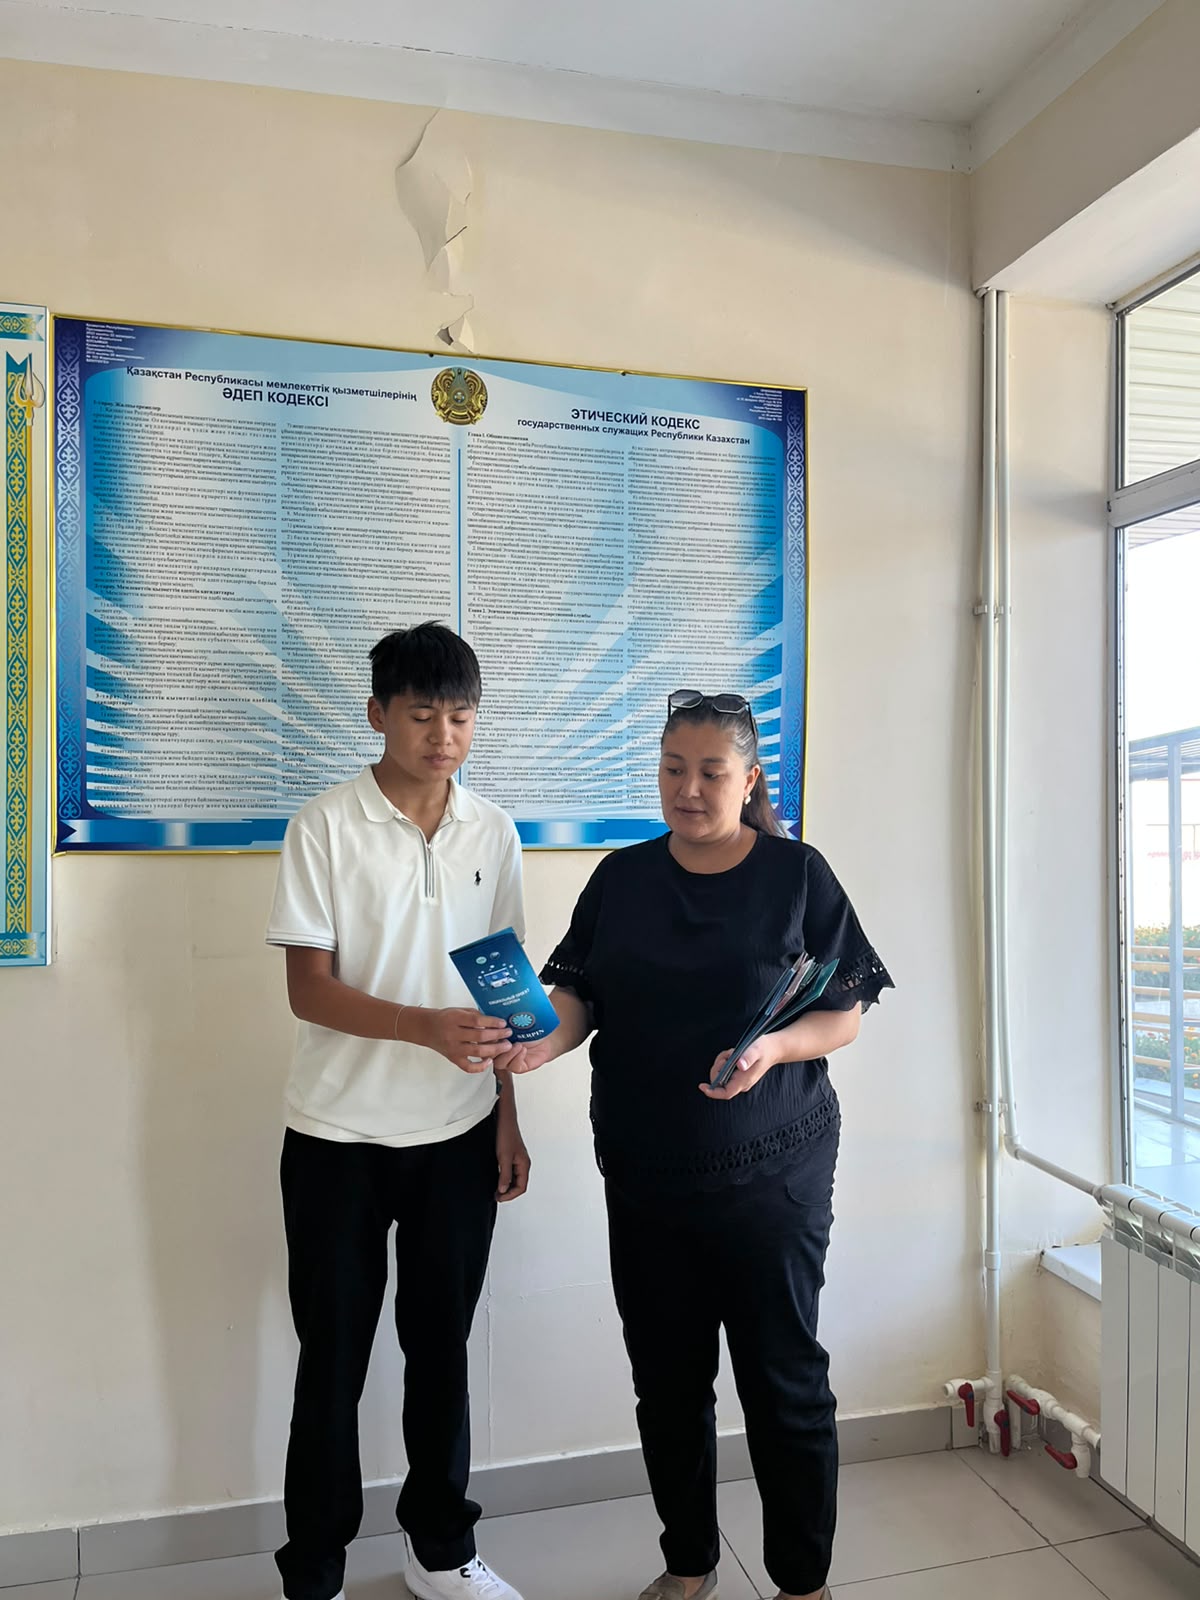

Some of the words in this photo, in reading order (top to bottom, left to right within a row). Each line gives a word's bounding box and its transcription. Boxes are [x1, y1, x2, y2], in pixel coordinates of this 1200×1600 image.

[126, 366, 182, 380] Қазақстан
[185, 372, 263, 387] Республикасы
[266, 380, 330, 392] мемлекеттік
[332, 387, 417, 401] қызметшілерінің
[222, 388, 262, 402] ӘДЕП
[268, 392, 328, 407] КОДЕКСІ
[571, 408, 648, 425] ЭТИЧЕСКИЙ
[652, 416, 700, 430] КОДЕКС
[518, 420, 600, 432] государственных
[602, 426, 648, 437] служащих
[651, 429, 704, 440] Республики
[706, 434, 750, 444] Казахстан
[517, 1029, 544, 1039] SERPIN
